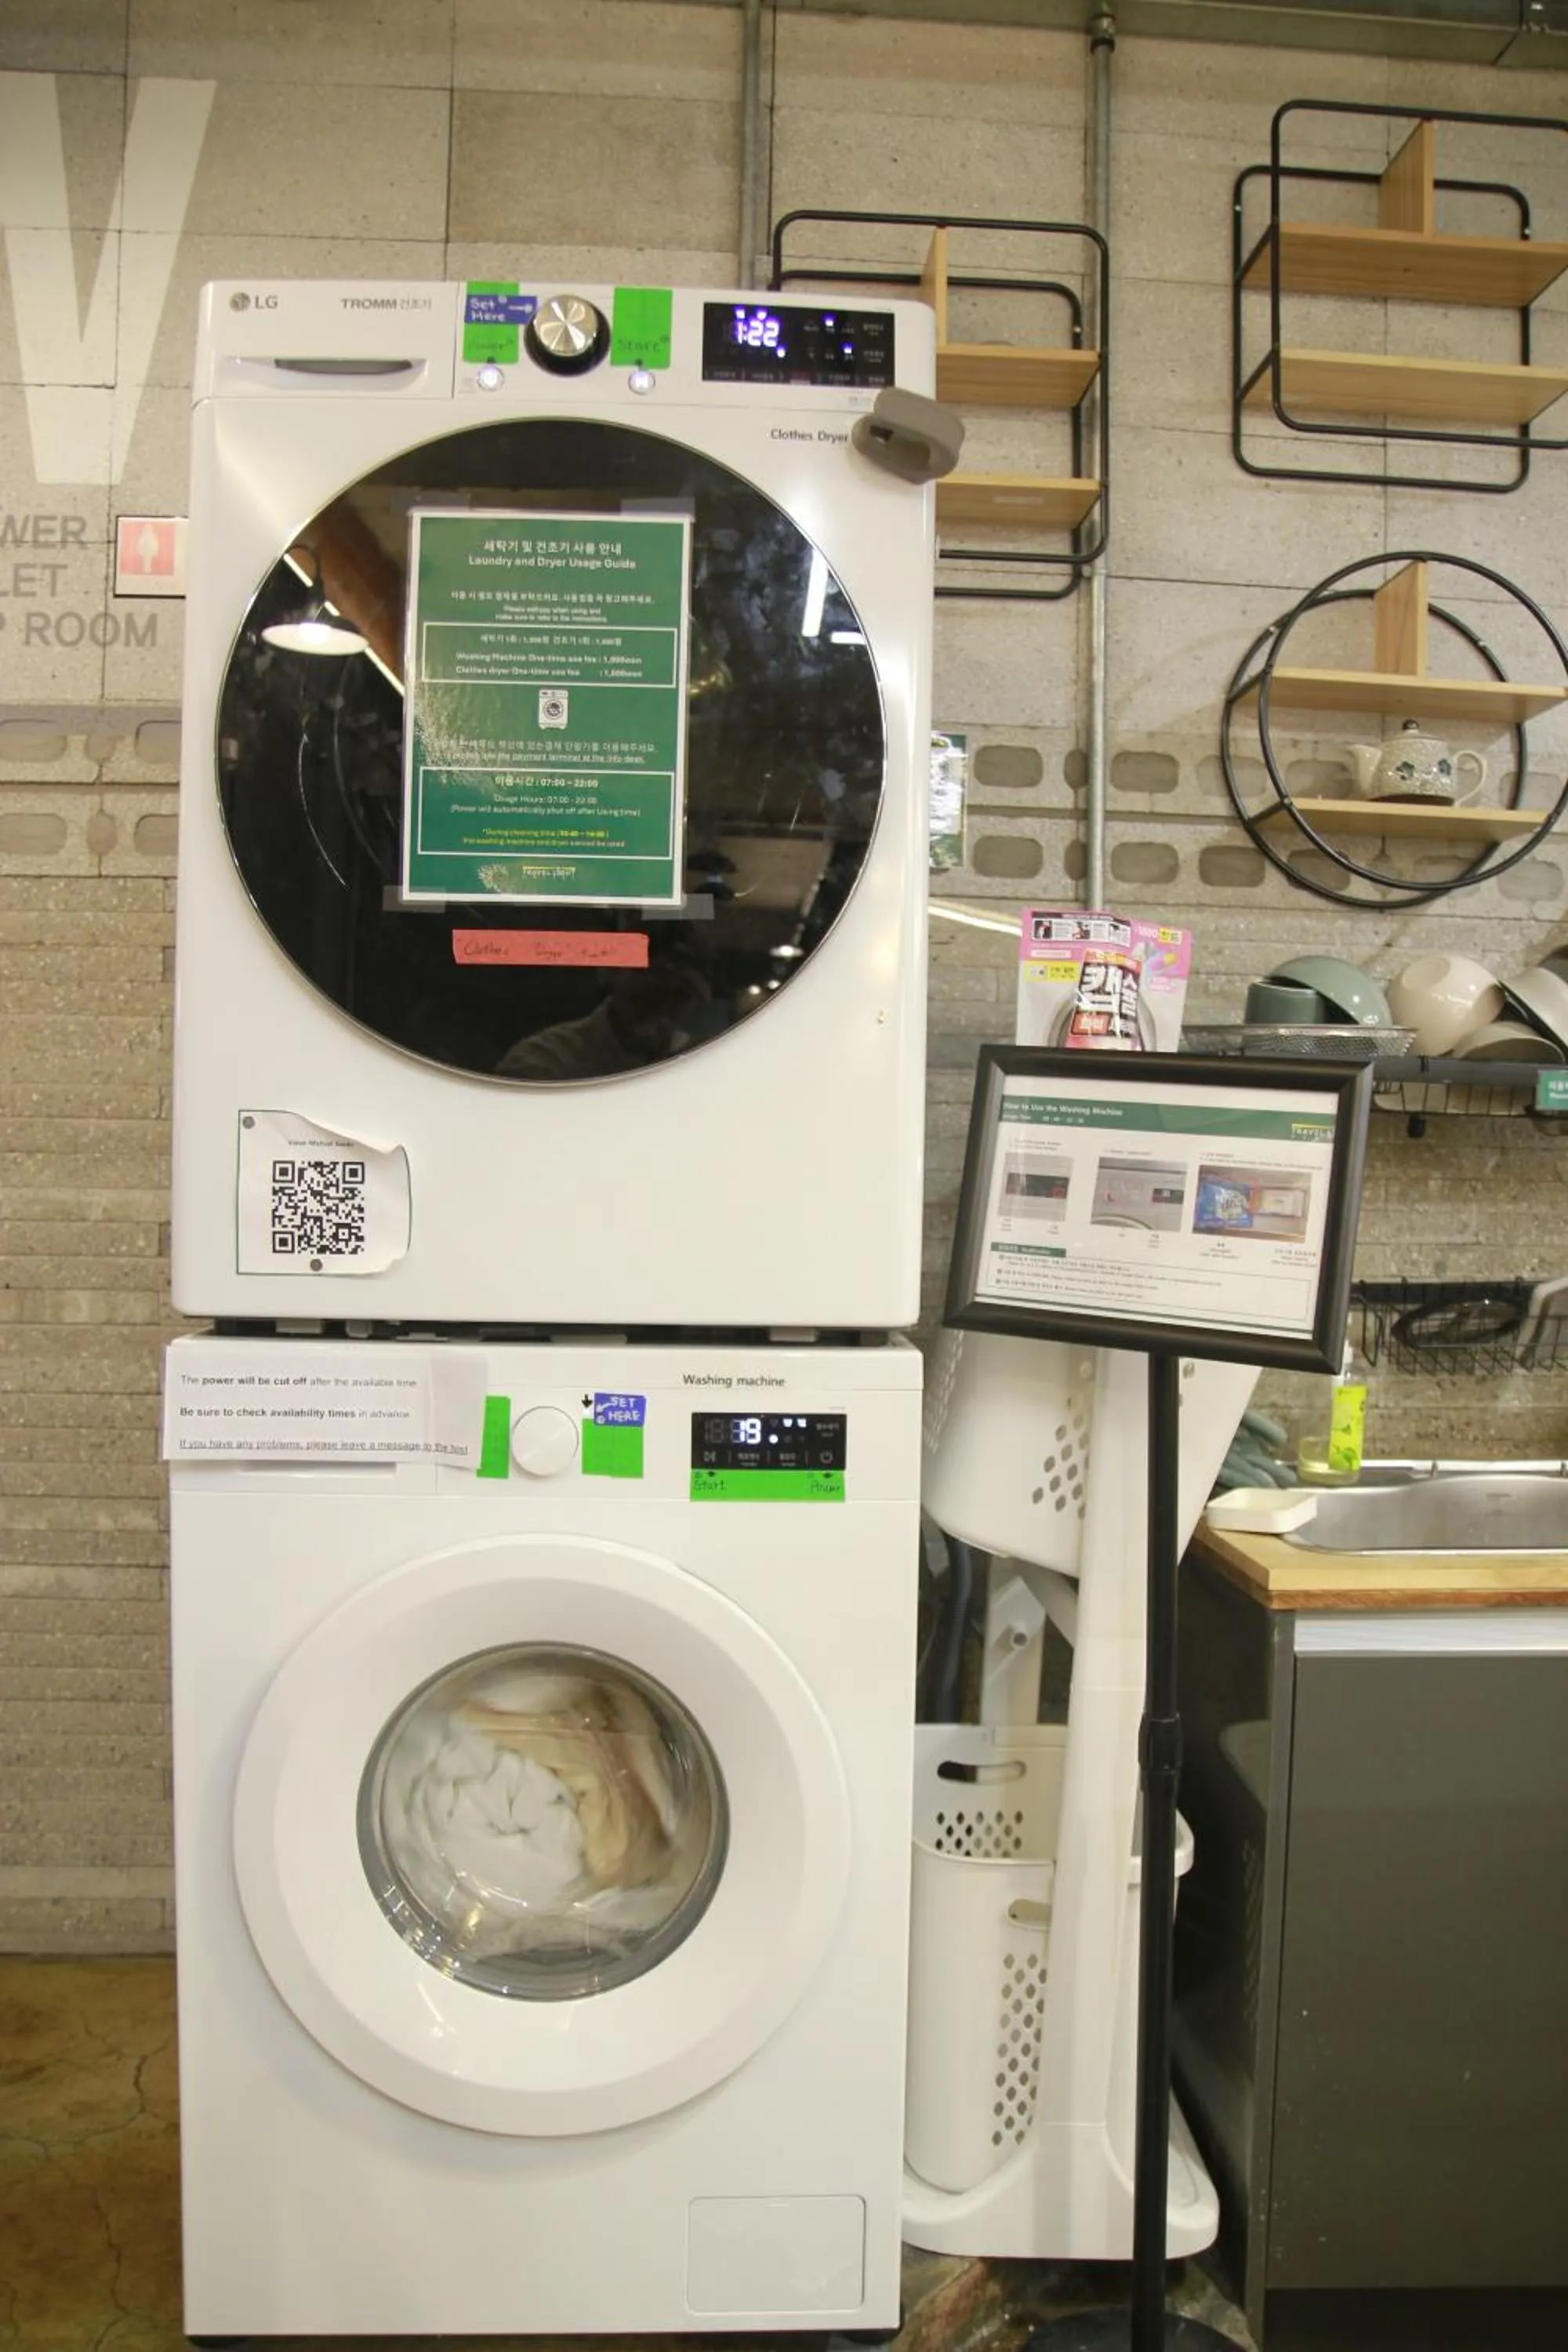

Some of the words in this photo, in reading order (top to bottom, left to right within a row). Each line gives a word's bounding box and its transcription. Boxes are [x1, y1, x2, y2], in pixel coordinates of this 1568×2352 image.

[254, 295, 278, 310] LG
[340, 298, 397, 310] TROMM
[770, 428, 813, 441] Clothes
[818, 430, 849, 444] Dryer
[484, 539, 519, 553] 세탁기
[522, 541, 533, 554] 및
[536, 541, 571, 554] 건조기
[574, 542, 596, 556] 사용
[599, 543, 622, 556] 안내
[469, 555, 513, 568] Laundry
[515, 556, 535, 566] and
[537, 557, 567, 569] Dryer
[569, 558, 602, 569] Usage
[604, 559, 637, 569] Guide
[24, 611, 159, 648] ROOM
[181, 1375, 198, 1385] The
[201, 1377, 234, 1386] power
[238, 1376, 255, 1385] will
[258, 1377, 270, 1385] be
[274, 1377, 290, 1385] cut
[292, 1376, 307, 1385] off
[310, 1377, 332, 1387] after
[334, 1377, 349, 1387] the
[352, 1377, 394, 1387] available
[683, 1374, 733, 1388] Washing
[737, 1375, 786, 1387] machine
[610, 1396, 637, 1408] SET
[180, 1407, 194, 1417] Be
[197, 1408, 220, 1417] sure
[223, 1408, 234, 1417] to
[236, 1407, 267, 1417] check
[270, 1408, 325, 1420] availability
[328, 1410, 355, 1418] times
[370, 1410, 410, 1419] advance
[608, 1410, 640, 1422] HERE
[188, 1441, 207, 1450] you
[209, 1439, 234, 1450] have
[236, 1441, 254, 1451] any
[306, 1441, 338, 1451] please
[340, 1441, 366, 1451] leave
[377, 1442, 421, 1452] message
[434, 1443, 448, 1454] the
